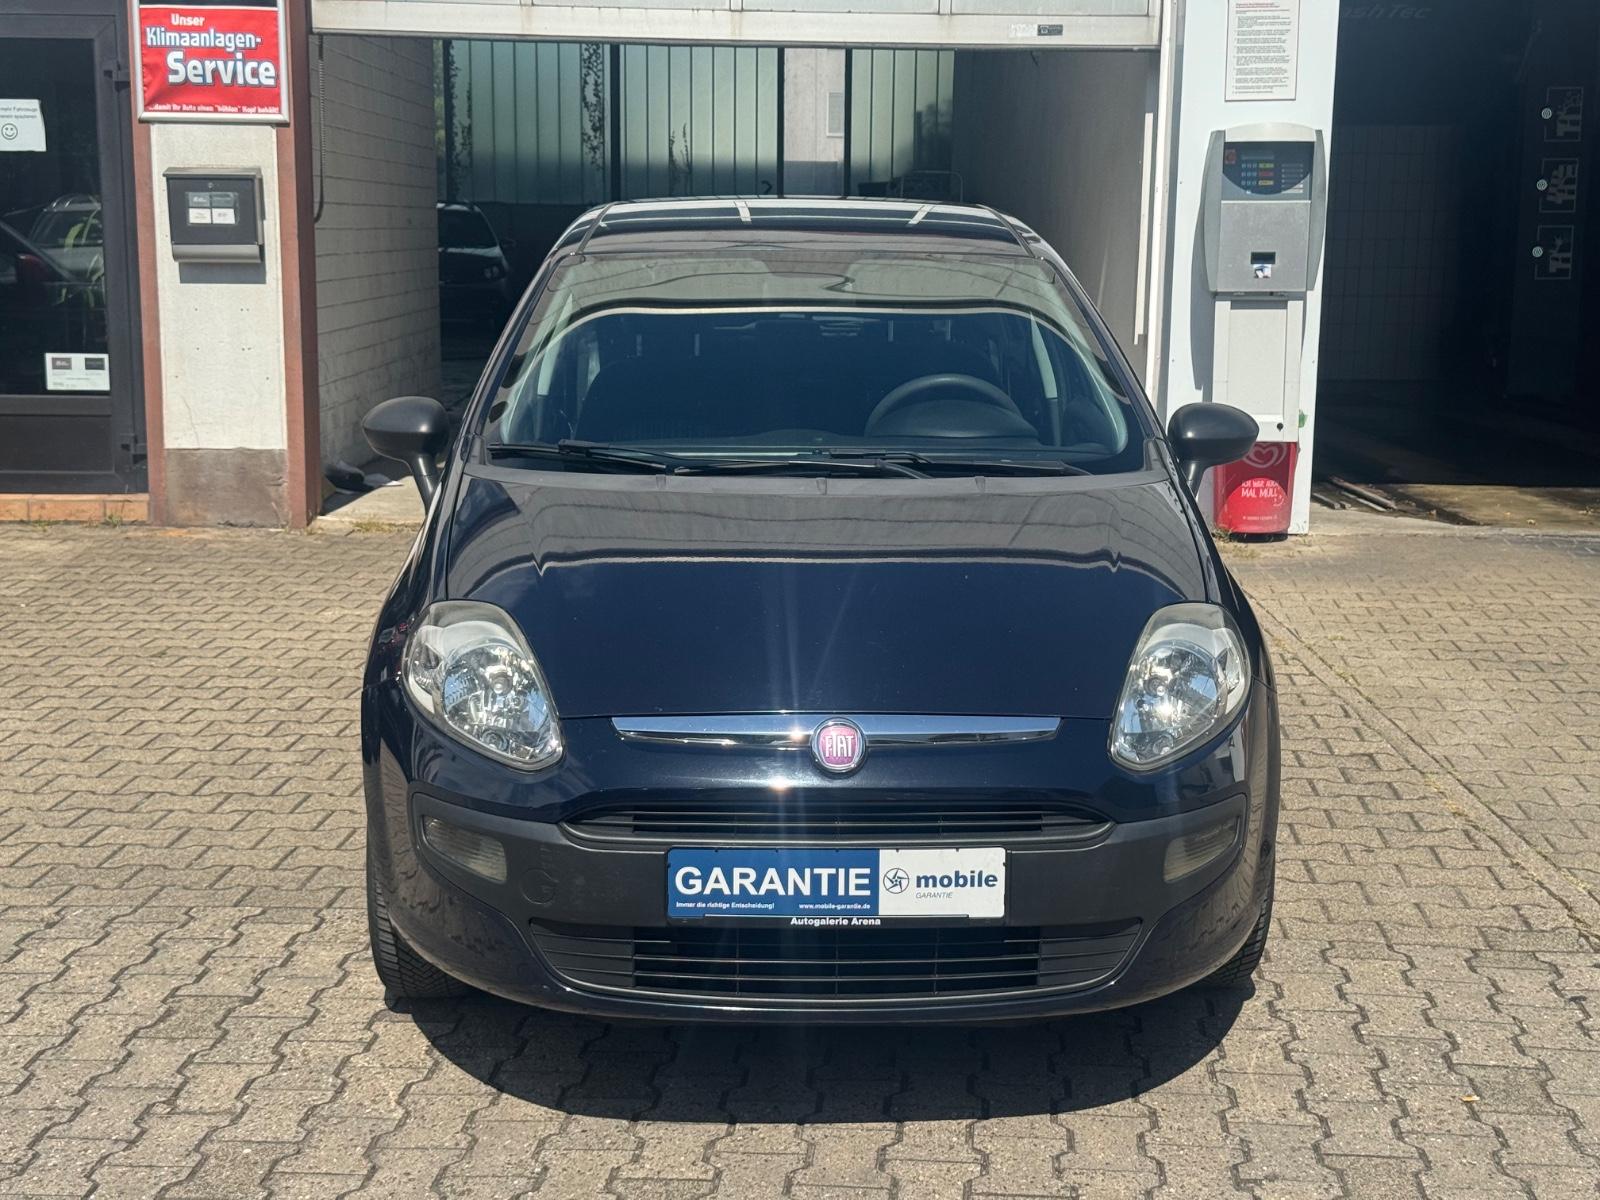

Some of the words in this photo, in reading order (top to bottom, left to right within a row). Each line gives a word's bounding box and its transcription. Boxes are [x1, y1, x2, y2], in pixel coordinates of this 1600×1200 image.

[171, 13, 205, 26] Unser
[146, 27, 262, 52] Klimaanlagen-
[166, 50, 277, 86] Service
[825, 732, 854, 758] FIAT
[674, 866, 871, 896] GARANTIE
[916, 870, 999, 888] mobile
[915, 892, 953, 900] GARANTIE
[731, 902, 775, 910] Entscheidung!
[790, 917, 849, 926] Autogalerie
[851, 917, 881, 926] Arena
